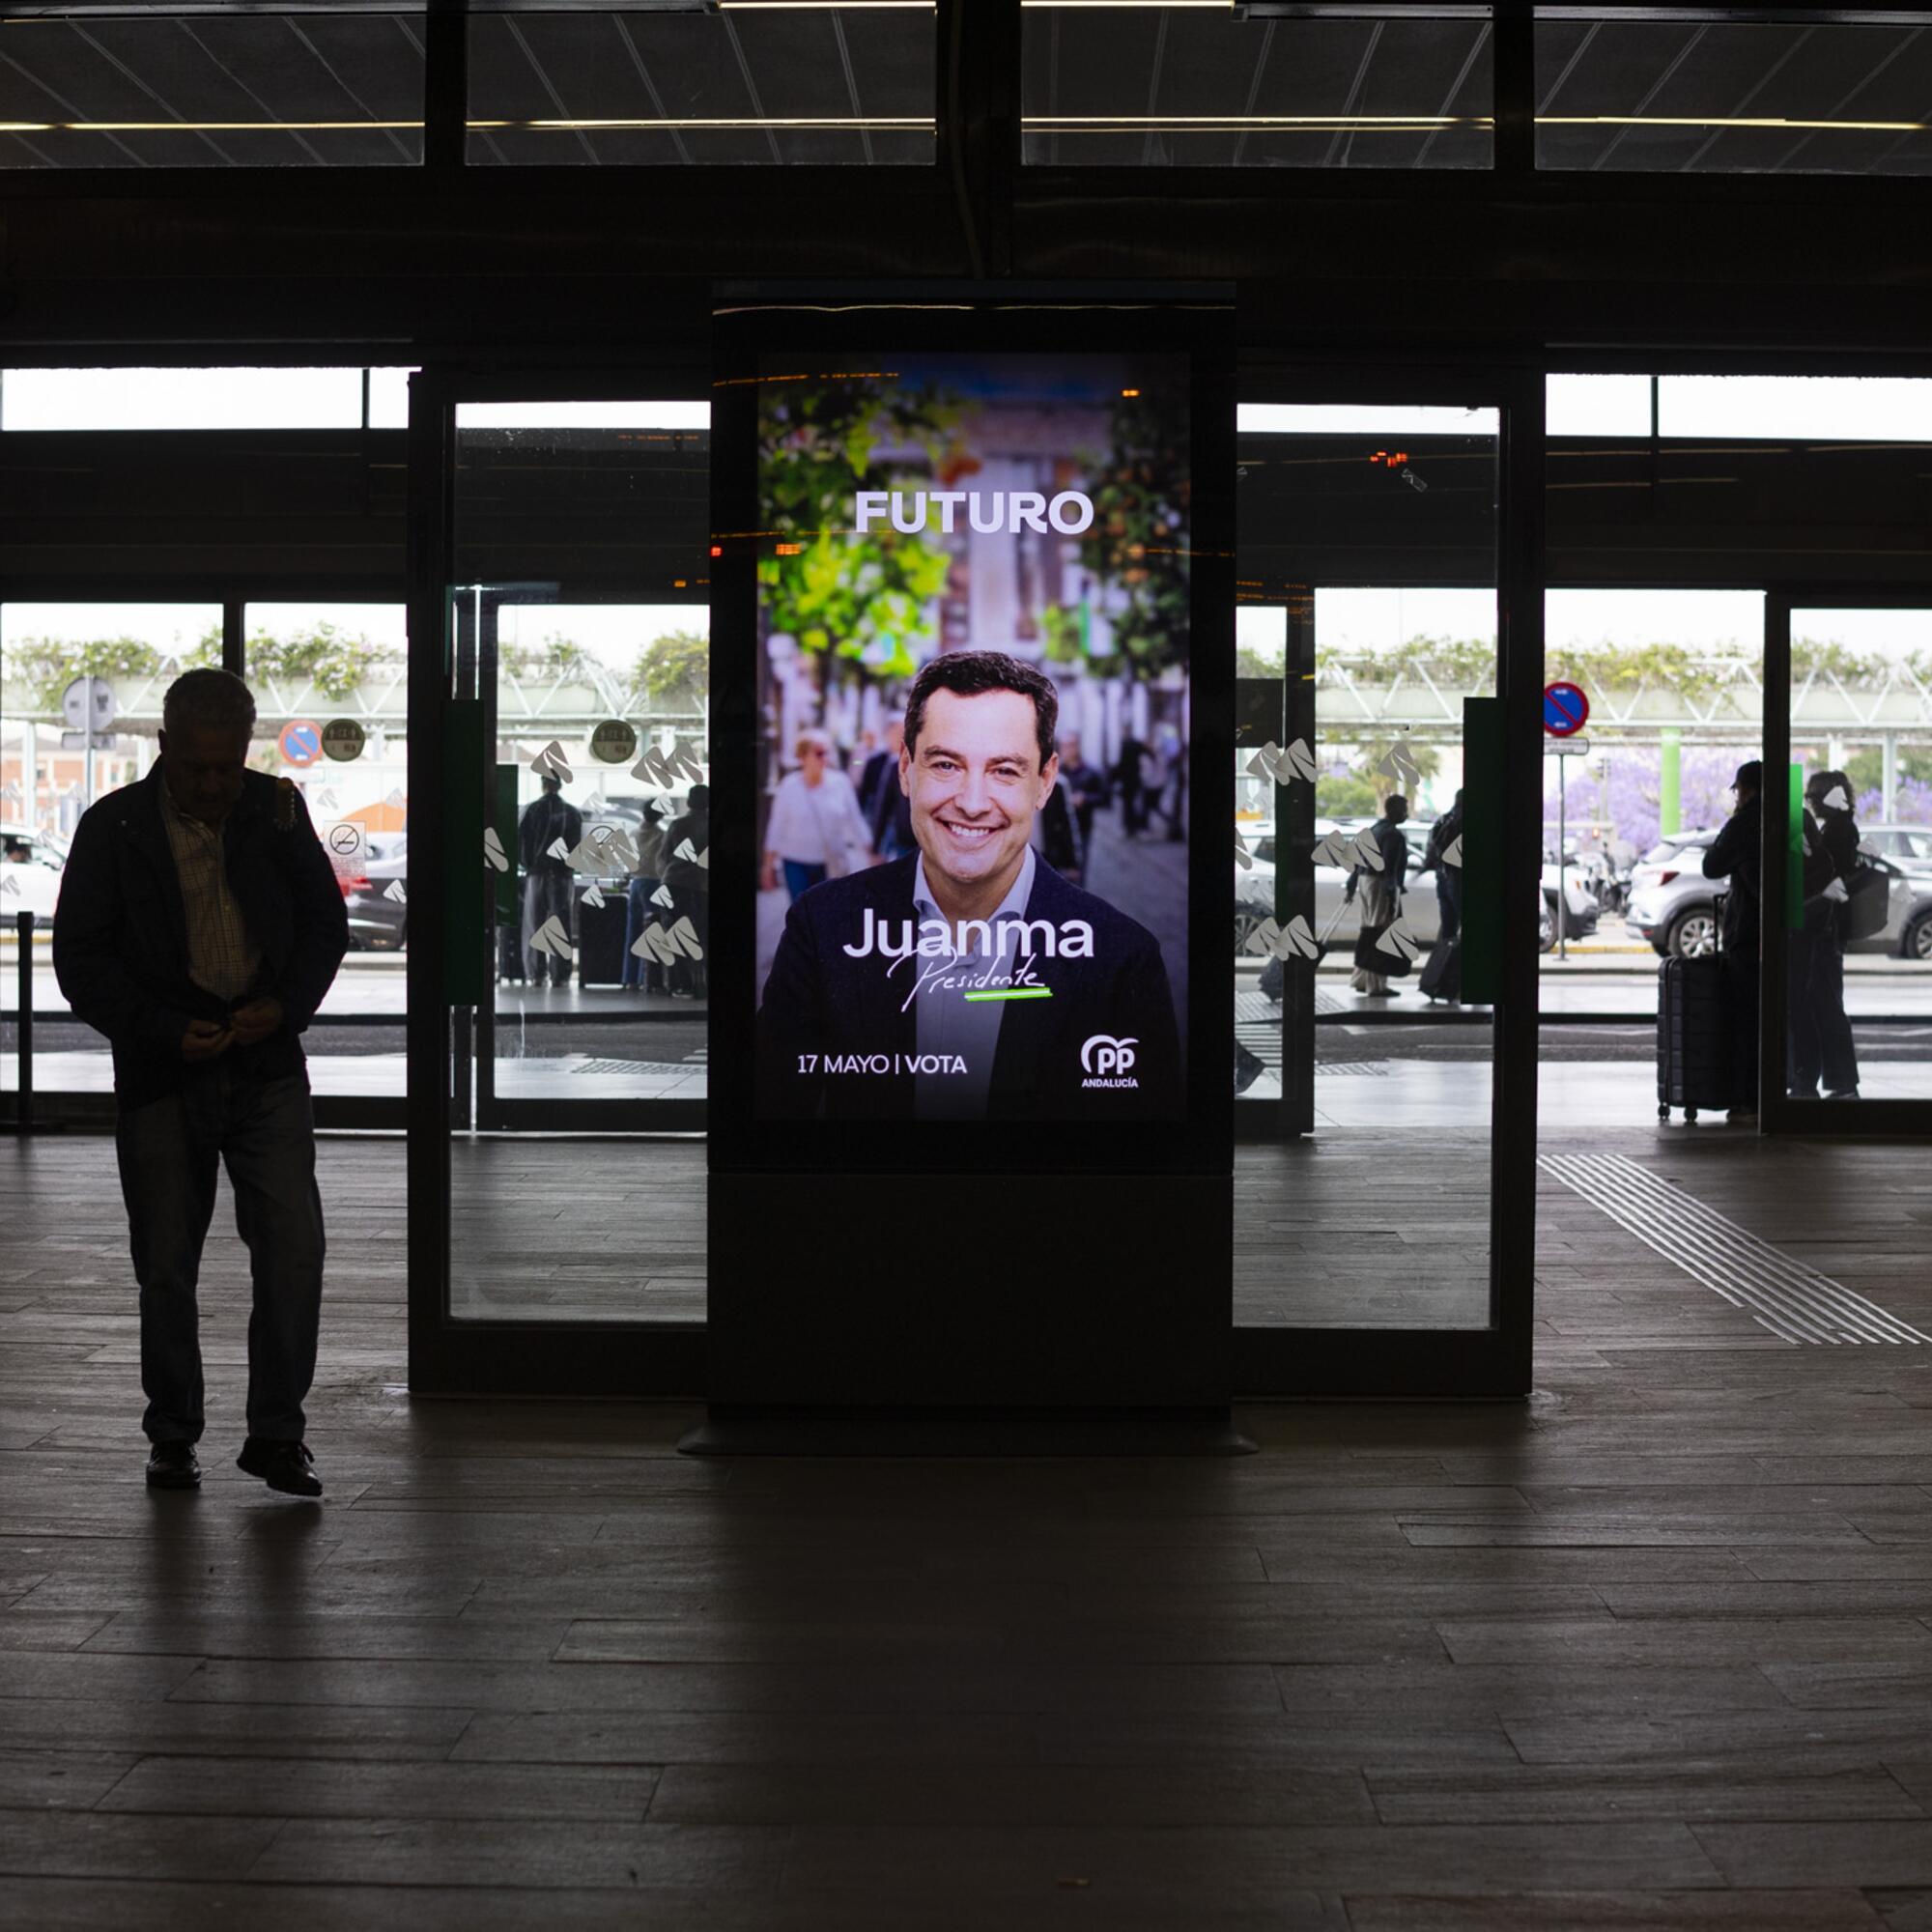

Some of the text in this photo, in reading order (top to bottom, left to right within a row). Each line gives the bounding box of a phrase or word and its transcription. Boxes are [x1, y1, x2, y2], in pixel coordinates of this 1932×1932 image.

[855, 491, 1094, 534] FUTURO
[842, 908, 1094, 957] Juanma
[887, 943, 1044, 1012] Presidente
[798, 1054, 817, 1073] 17
[824, 1054, 889, 1074] MAYO
[905, 1054, 968, 1074] VOTA
[1081, 1076, 1139, 1088] ANDALUCÍA
